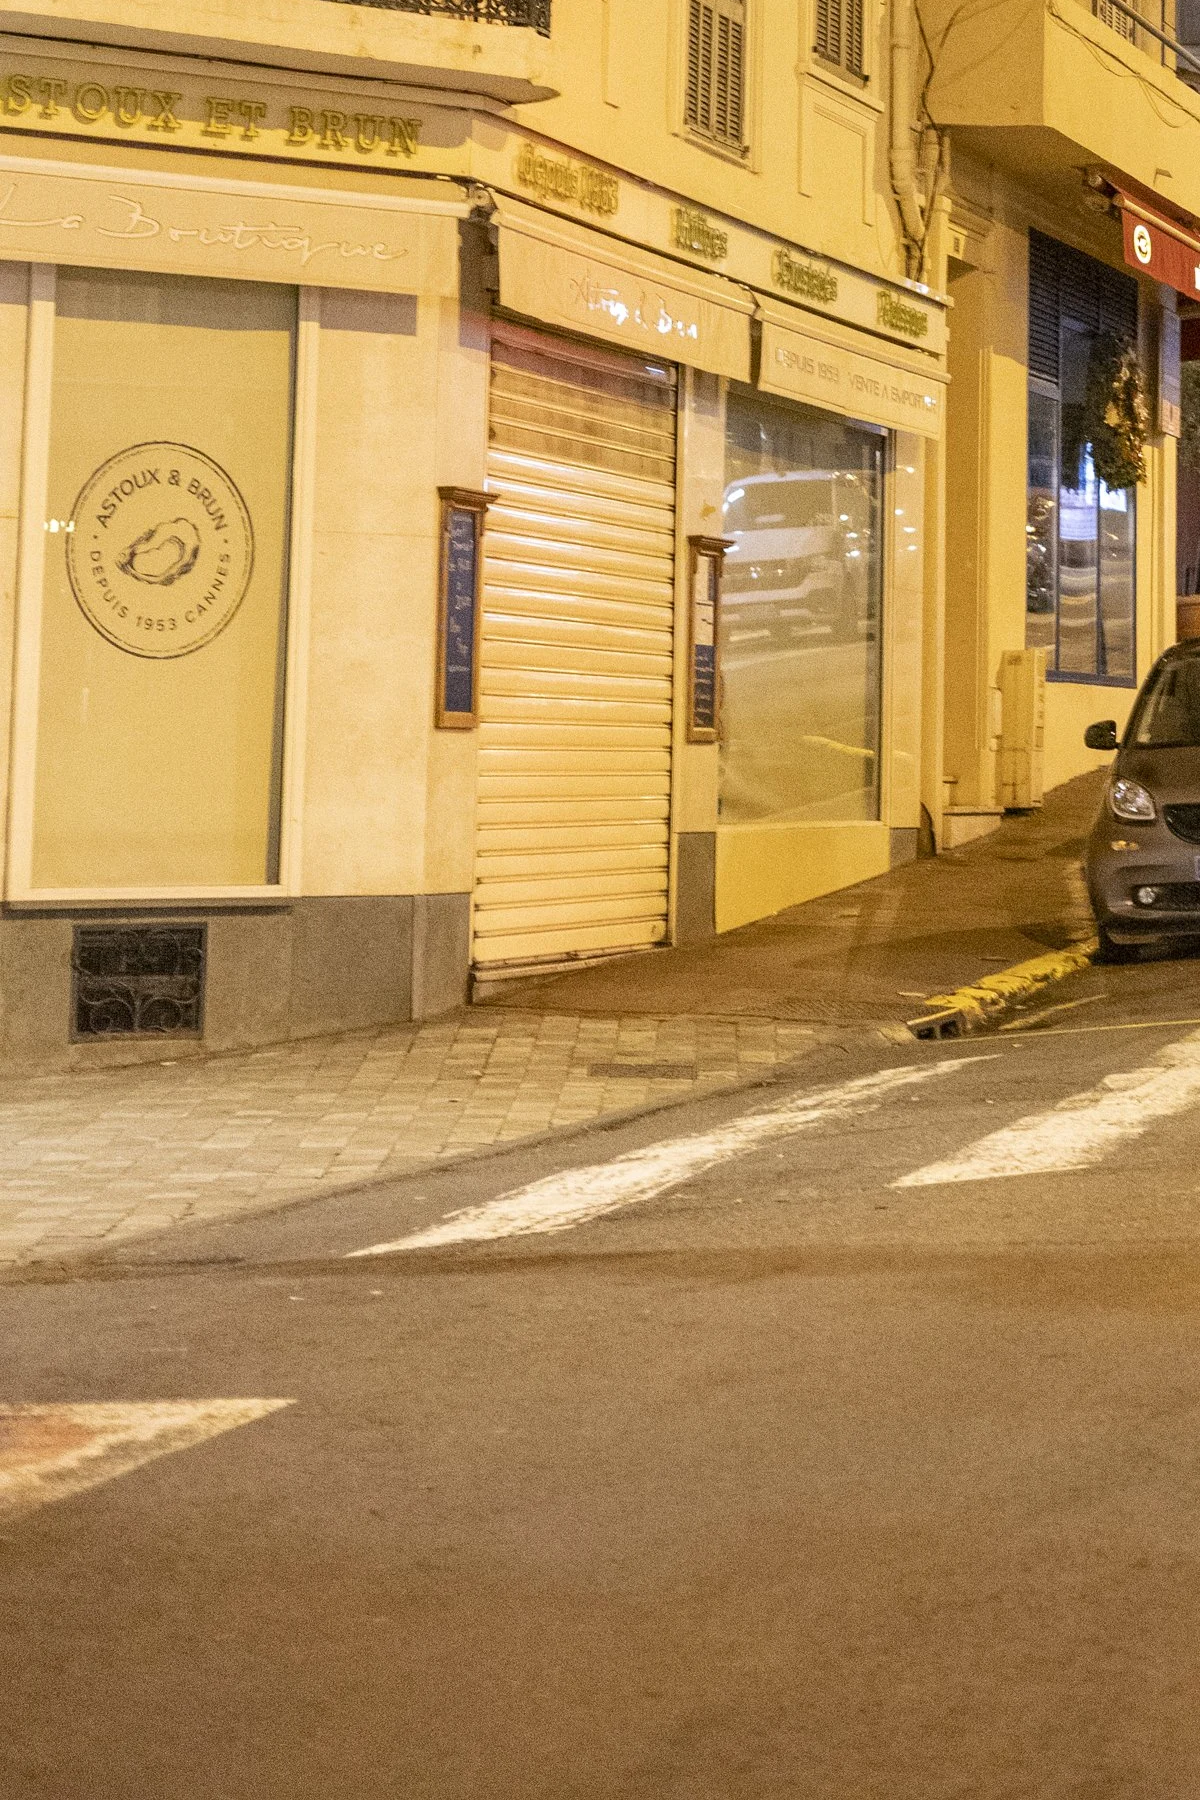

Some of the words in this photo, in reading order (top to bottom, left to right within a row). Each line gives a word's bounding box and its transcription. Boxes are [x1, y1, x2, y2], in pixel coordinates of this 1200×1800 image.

[0, 73, 183, 129] STOUX
[202, 96, 267, 138] ET
[287, 106, 422, 156] BRUN
[97, 194, 408, 266] Boutique
[96, 468, 161, 529] ASTOUX
[168, 469, 181, 487] &
[187, 477, 228, 531] BRUN
[90, 550, 129, 618] DEPUIS
[136, 615, 178, 632] 1953
[184, 553, 231, 624] CANNES
